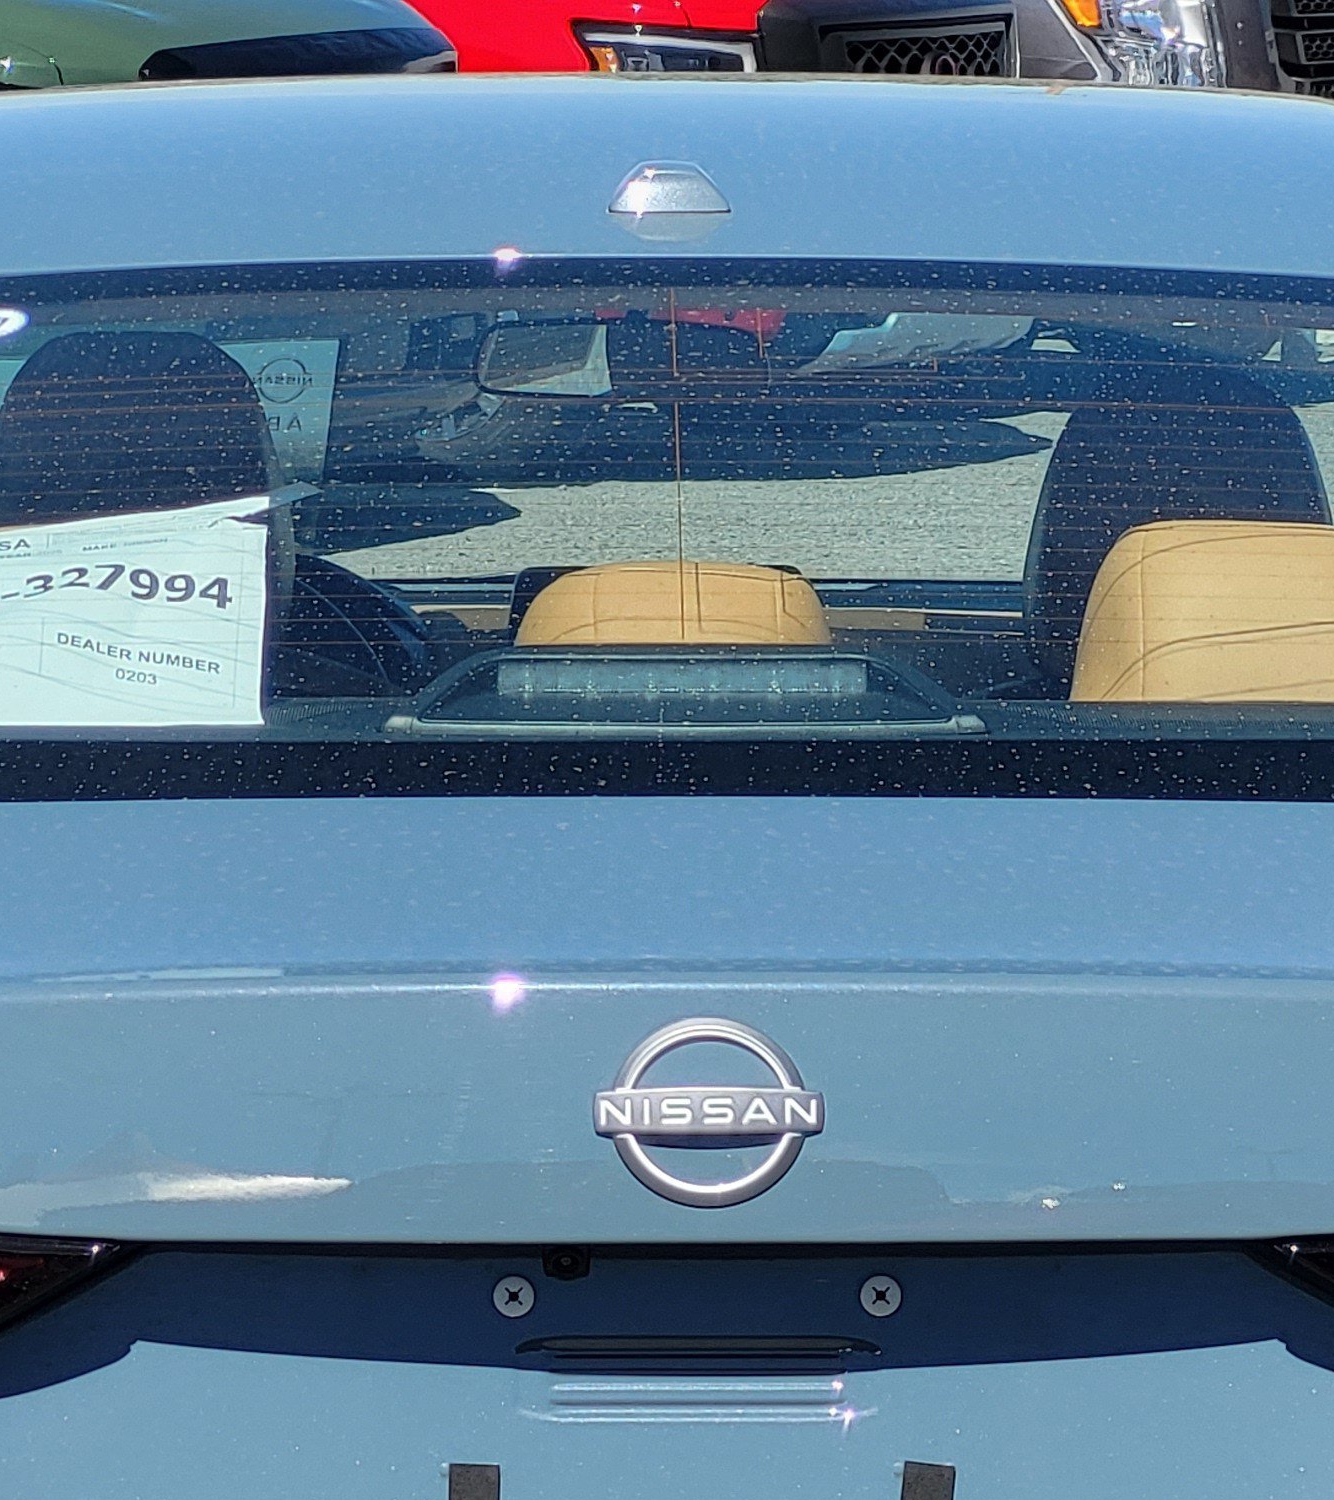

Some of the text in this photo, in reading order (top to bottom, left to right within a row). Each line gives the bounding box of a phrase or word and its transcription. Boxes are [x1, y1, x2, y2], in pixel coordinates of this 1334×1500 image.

[57, 632, 221, 675] DEALER NUMBER
[115, 668, 158, 686] 0203
[599, 1097, 818, 1126] NISSAN
